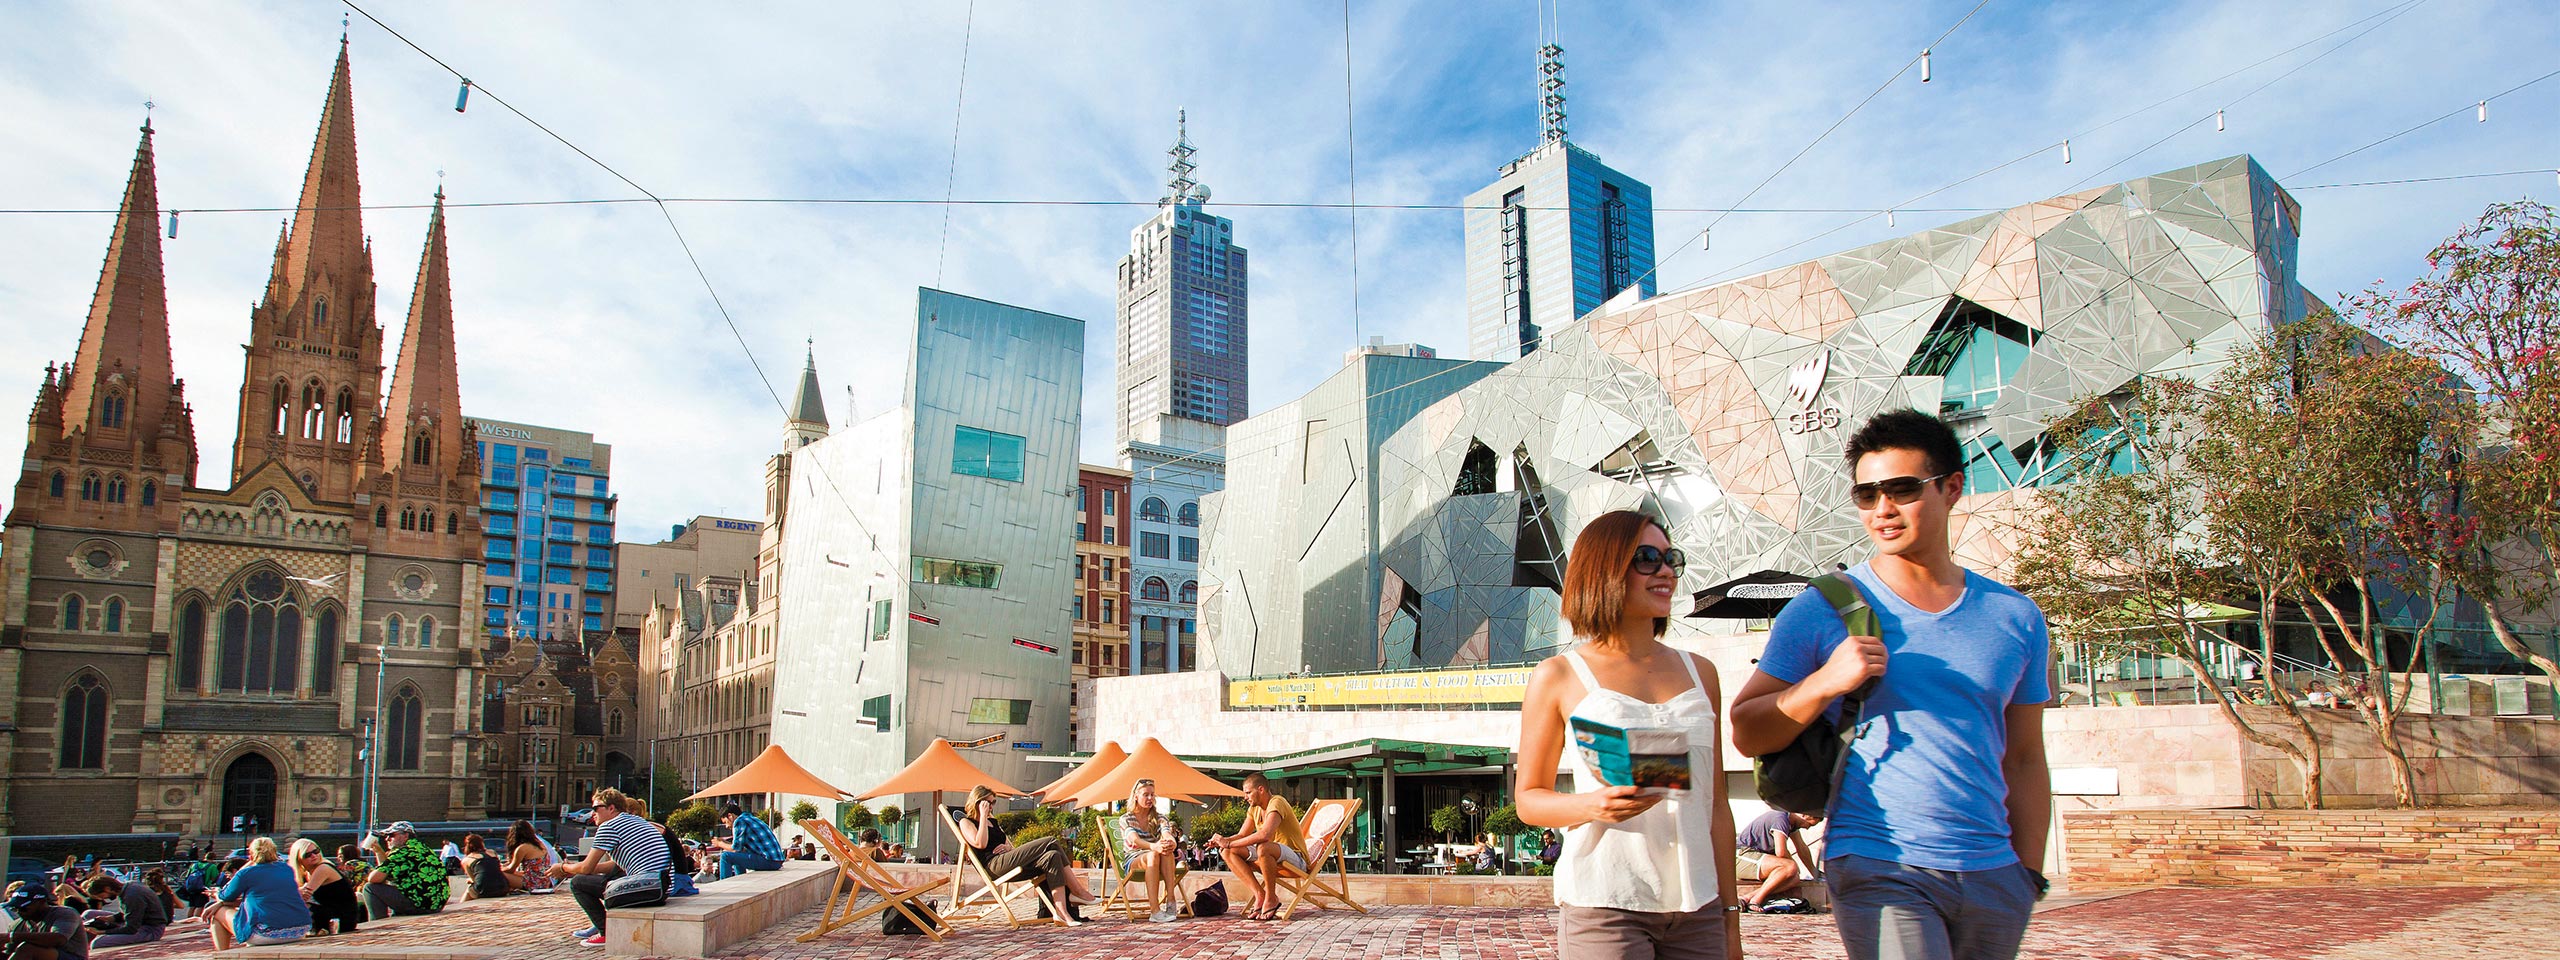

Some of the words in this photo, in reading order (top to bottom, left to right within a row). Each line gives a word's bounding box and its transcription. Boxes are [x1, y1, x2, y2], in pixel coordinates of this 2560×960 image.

[1789, 407, 1840, 435] SBS
[479, 422, 531, 440] WESTIN
[716, 520, 757, 532] REGENT
[1267, 685, 1282, 694] Sunday
[1290, 683, 1303, 693] March
[1346, 679, 1368, 690] THAI
[1373, 677, 1417, 689] CULTURE
[1422, 677, 1430, 688] &
[1437, 675, 1468, 687] FOOD
